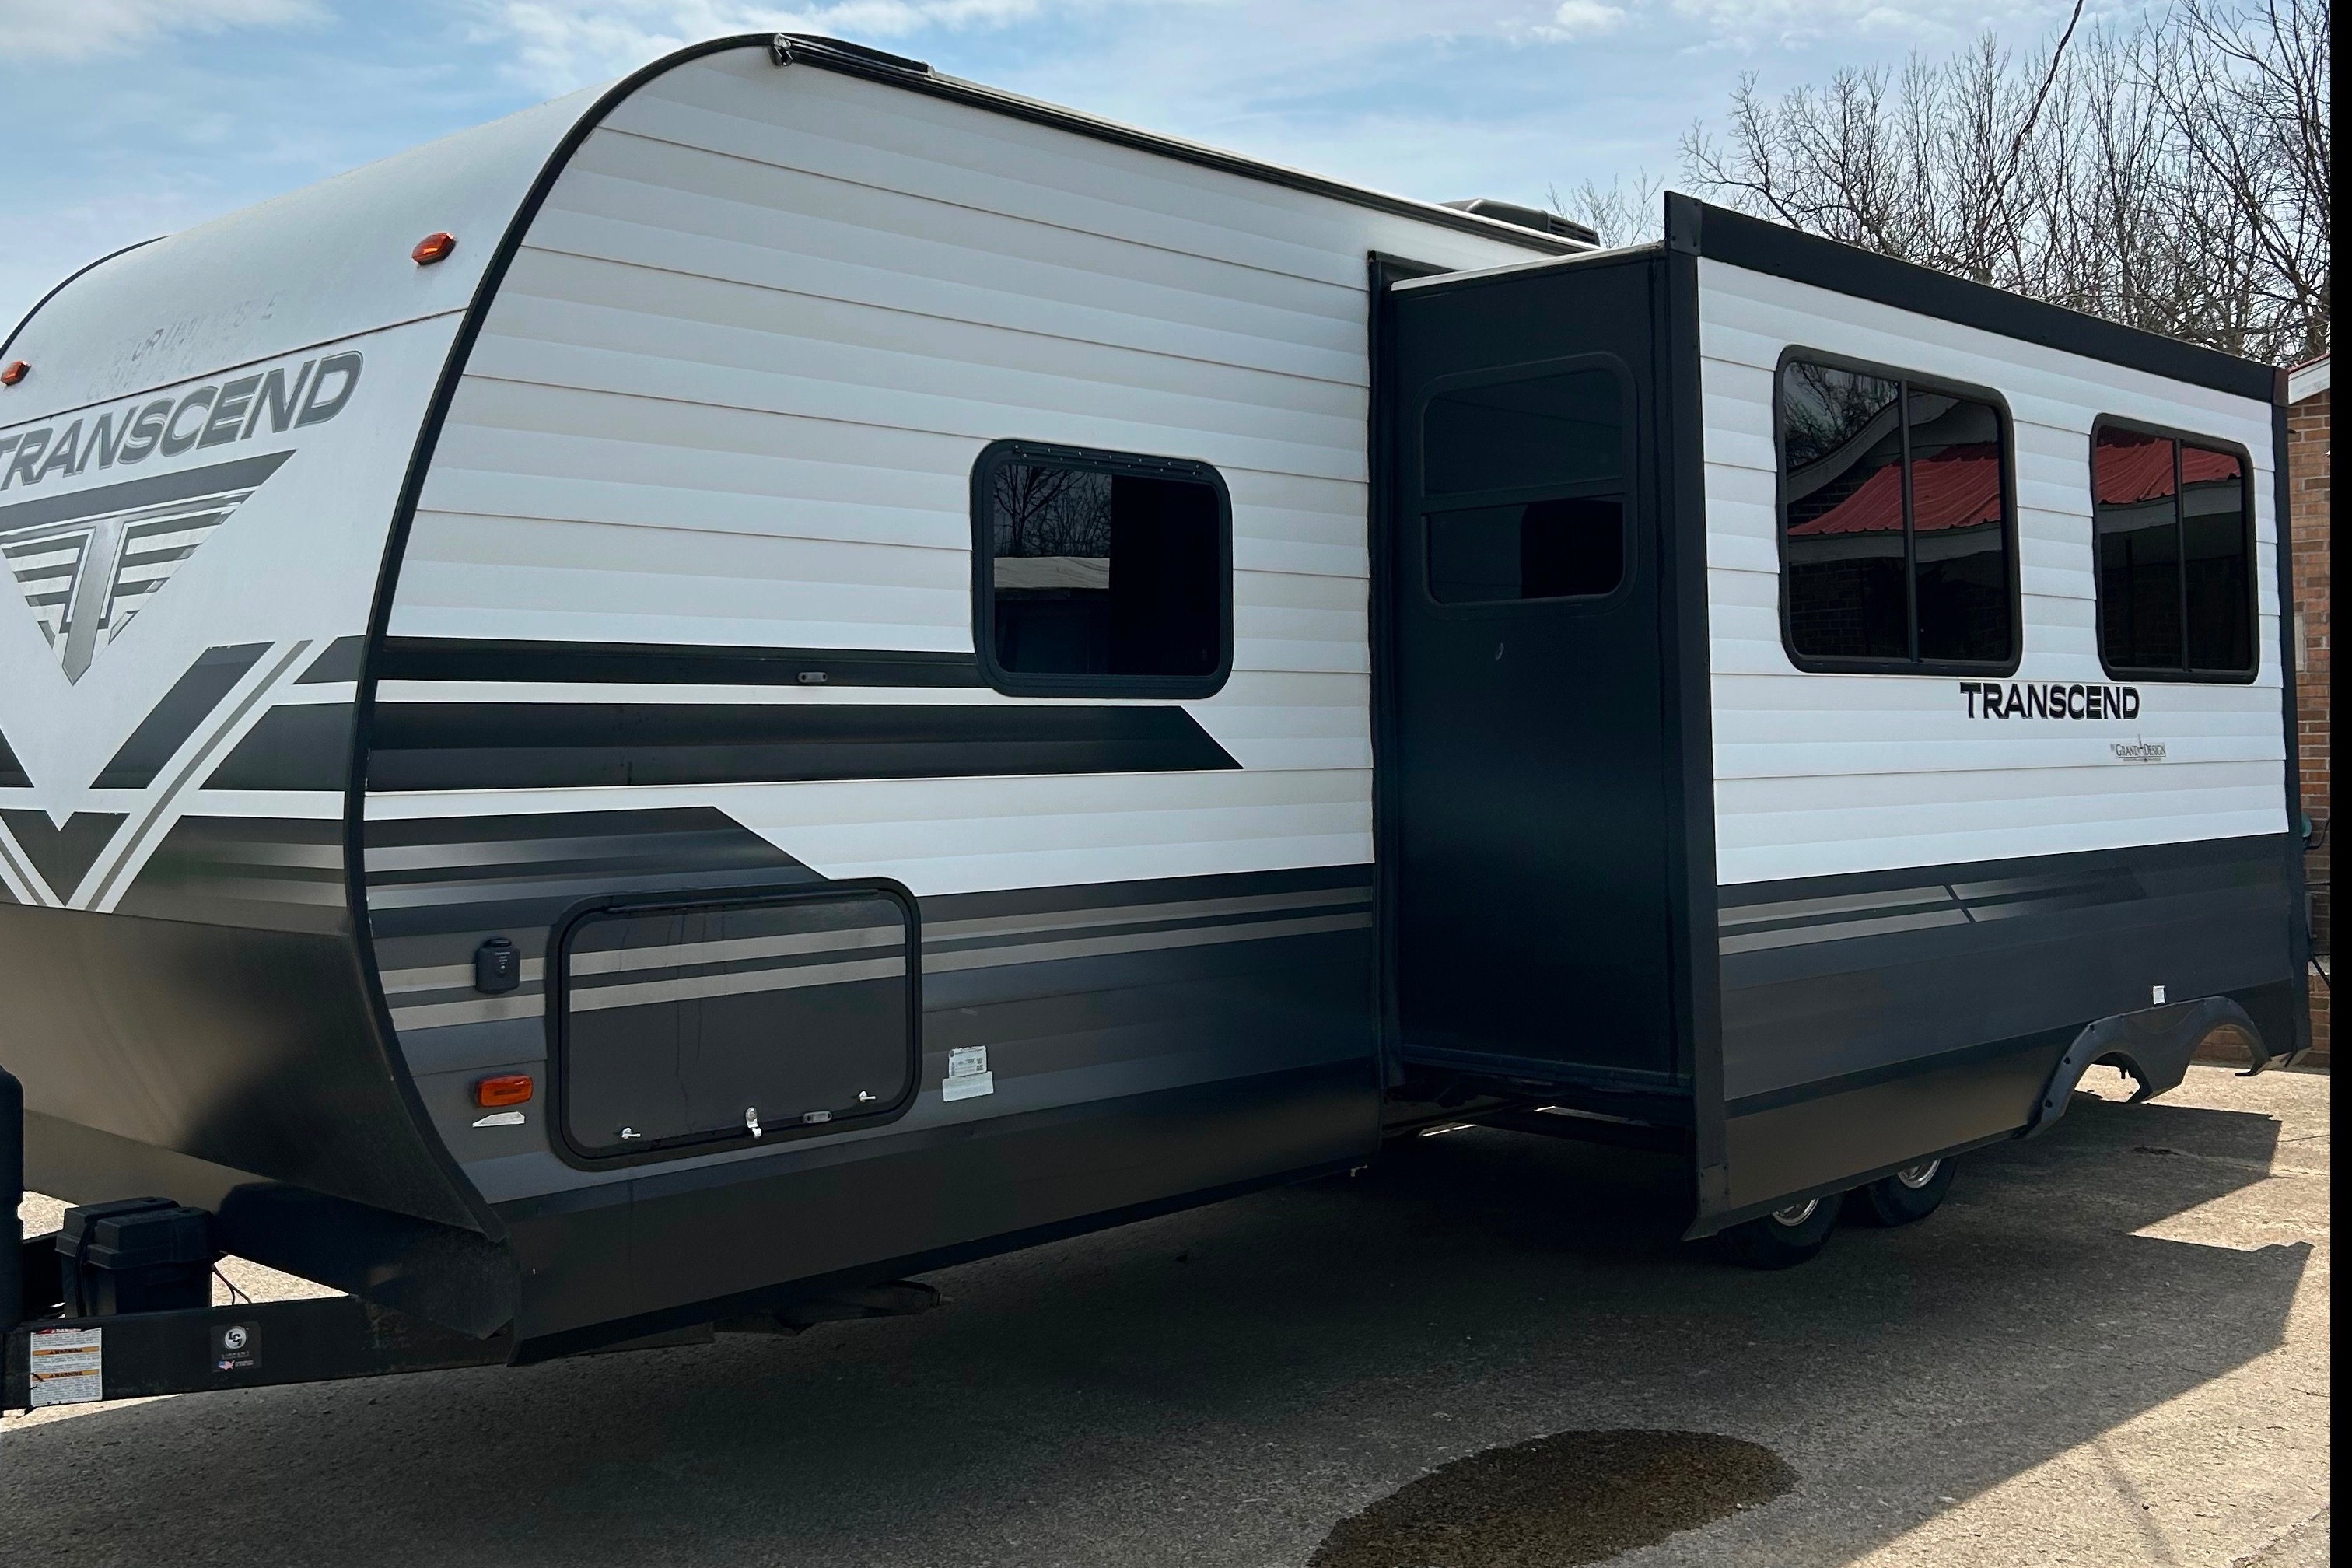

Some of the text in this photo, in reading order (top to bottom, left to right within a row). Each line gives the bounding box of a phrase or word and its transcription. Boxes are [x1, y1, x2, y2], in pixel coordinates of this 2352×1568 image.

[1959, 682, 2140, 720] TRANSCEND
[2116, 744, 2140, 757] GRAND
[2143, 743, 2166, 756] DESIGN
